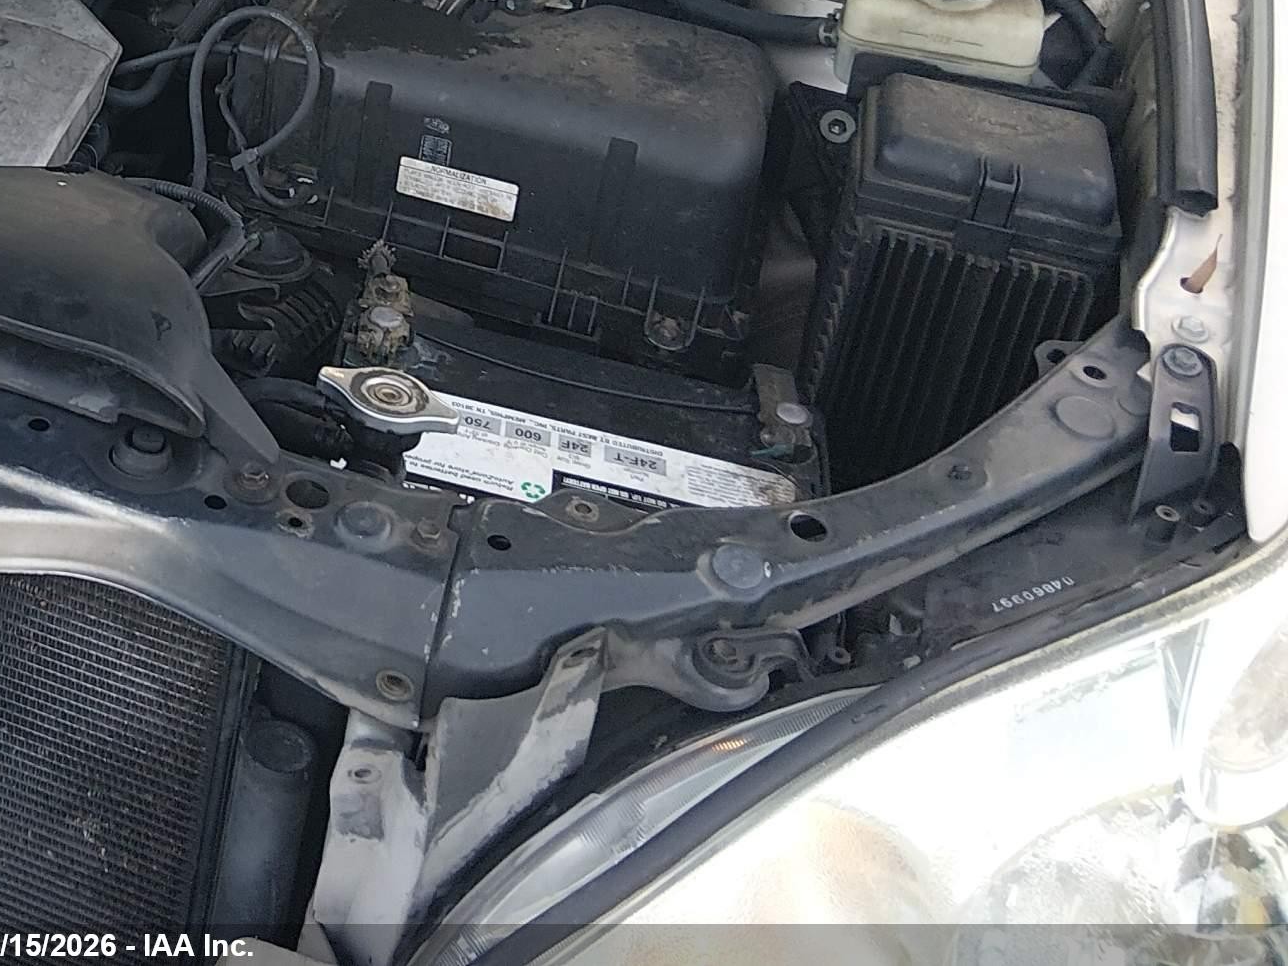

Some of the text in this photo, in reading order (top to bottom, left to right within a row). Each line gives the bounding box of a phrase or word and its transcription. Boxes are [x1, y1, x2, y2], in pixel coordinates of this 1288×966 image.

[465, 416, 491, 430] 750
[515, 427, 542, 441] 600
[578, 433, 597, 441] BEST
[561, 440, 589, 453] 24F
[613, 440, 663, 457] DISTRIBUTED
[613, 453, 657, 470] 24F-T
